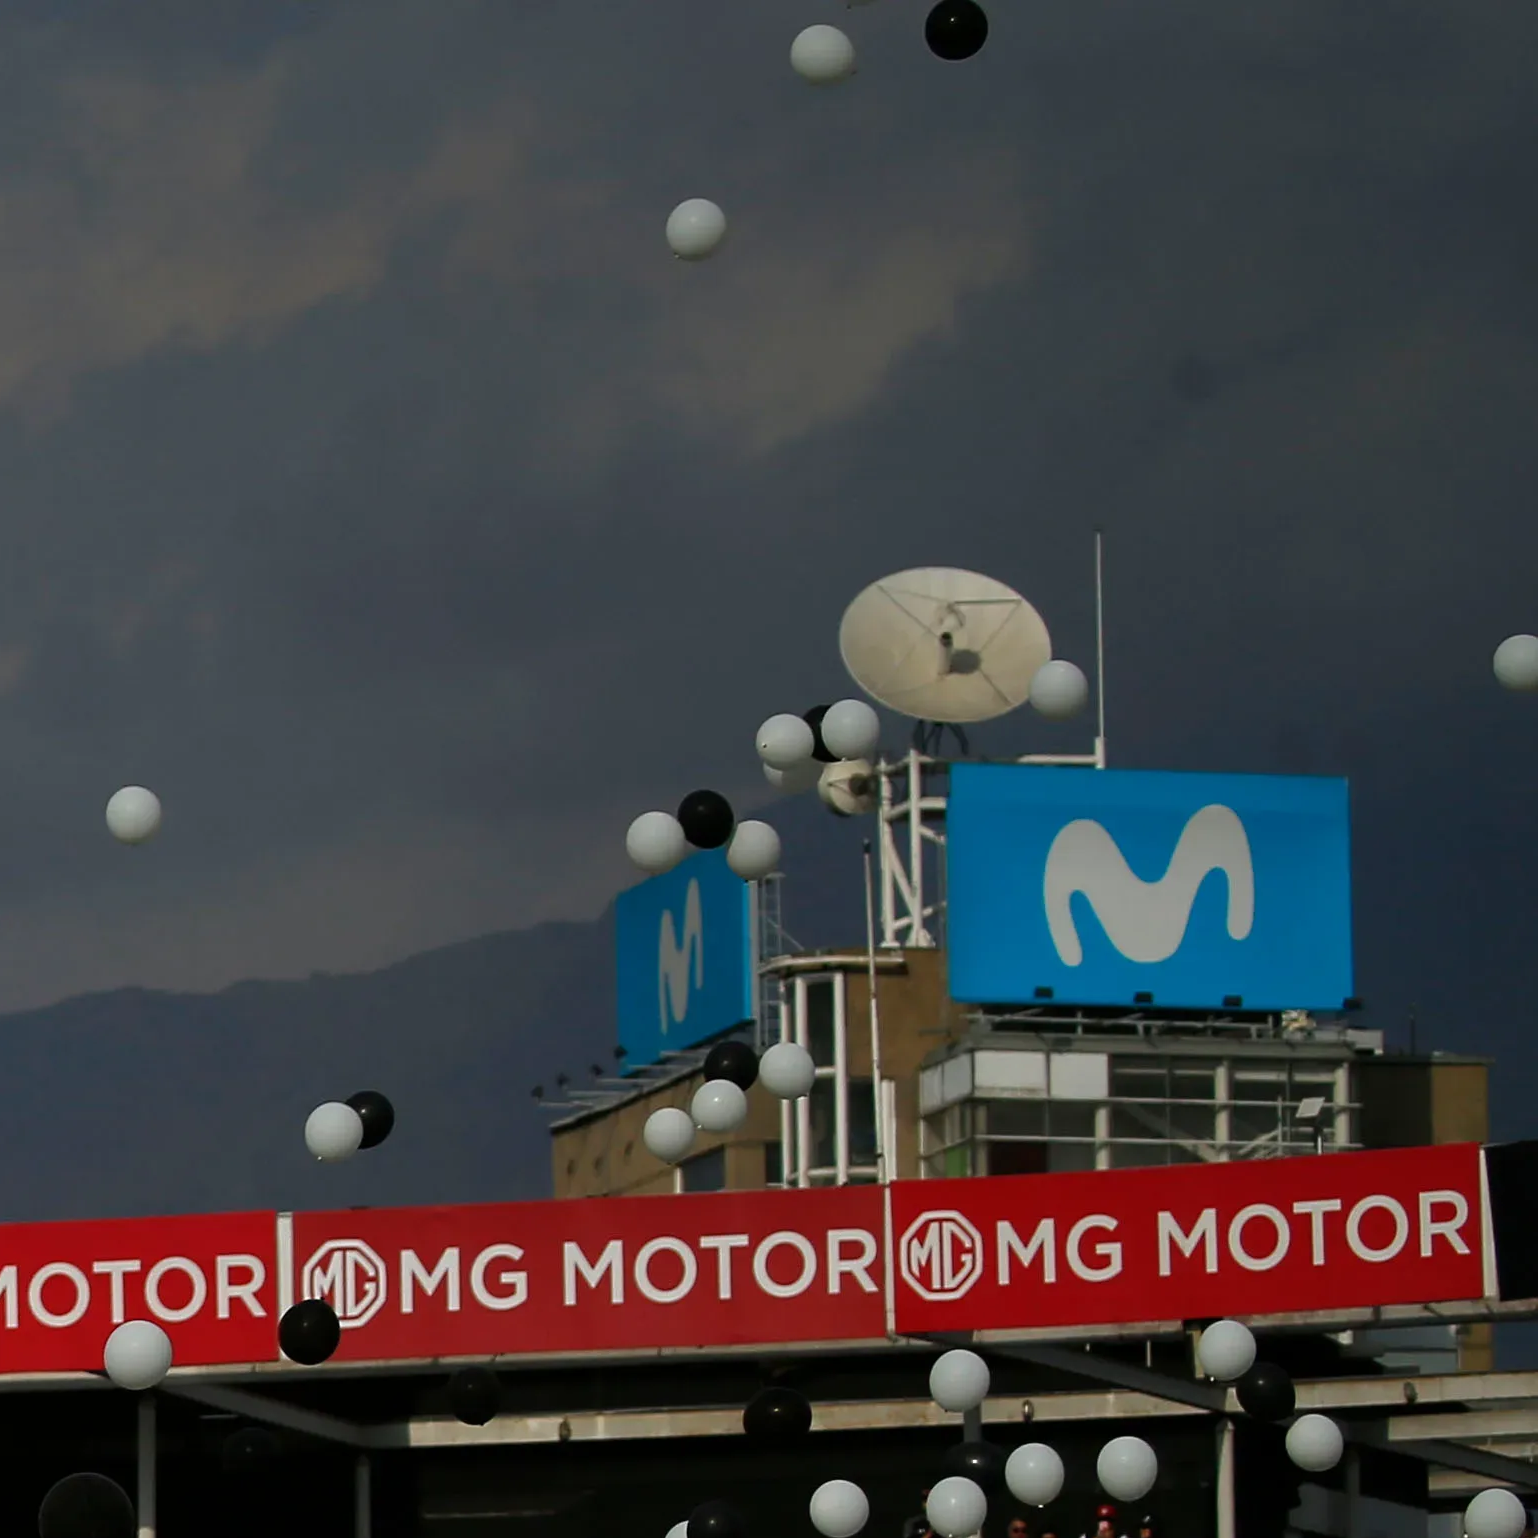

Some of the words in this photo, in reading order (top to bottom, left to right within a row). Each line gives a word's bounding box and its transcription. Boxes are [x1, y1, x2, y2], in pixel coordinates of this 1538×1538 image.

[400, 1243, 529, 1314] MG
[562, 1227, 879, 1307] MOTOR
[996, 1214, 1123, 1288] MG
[1156, 1190, 1473, 1279] MOTOR
